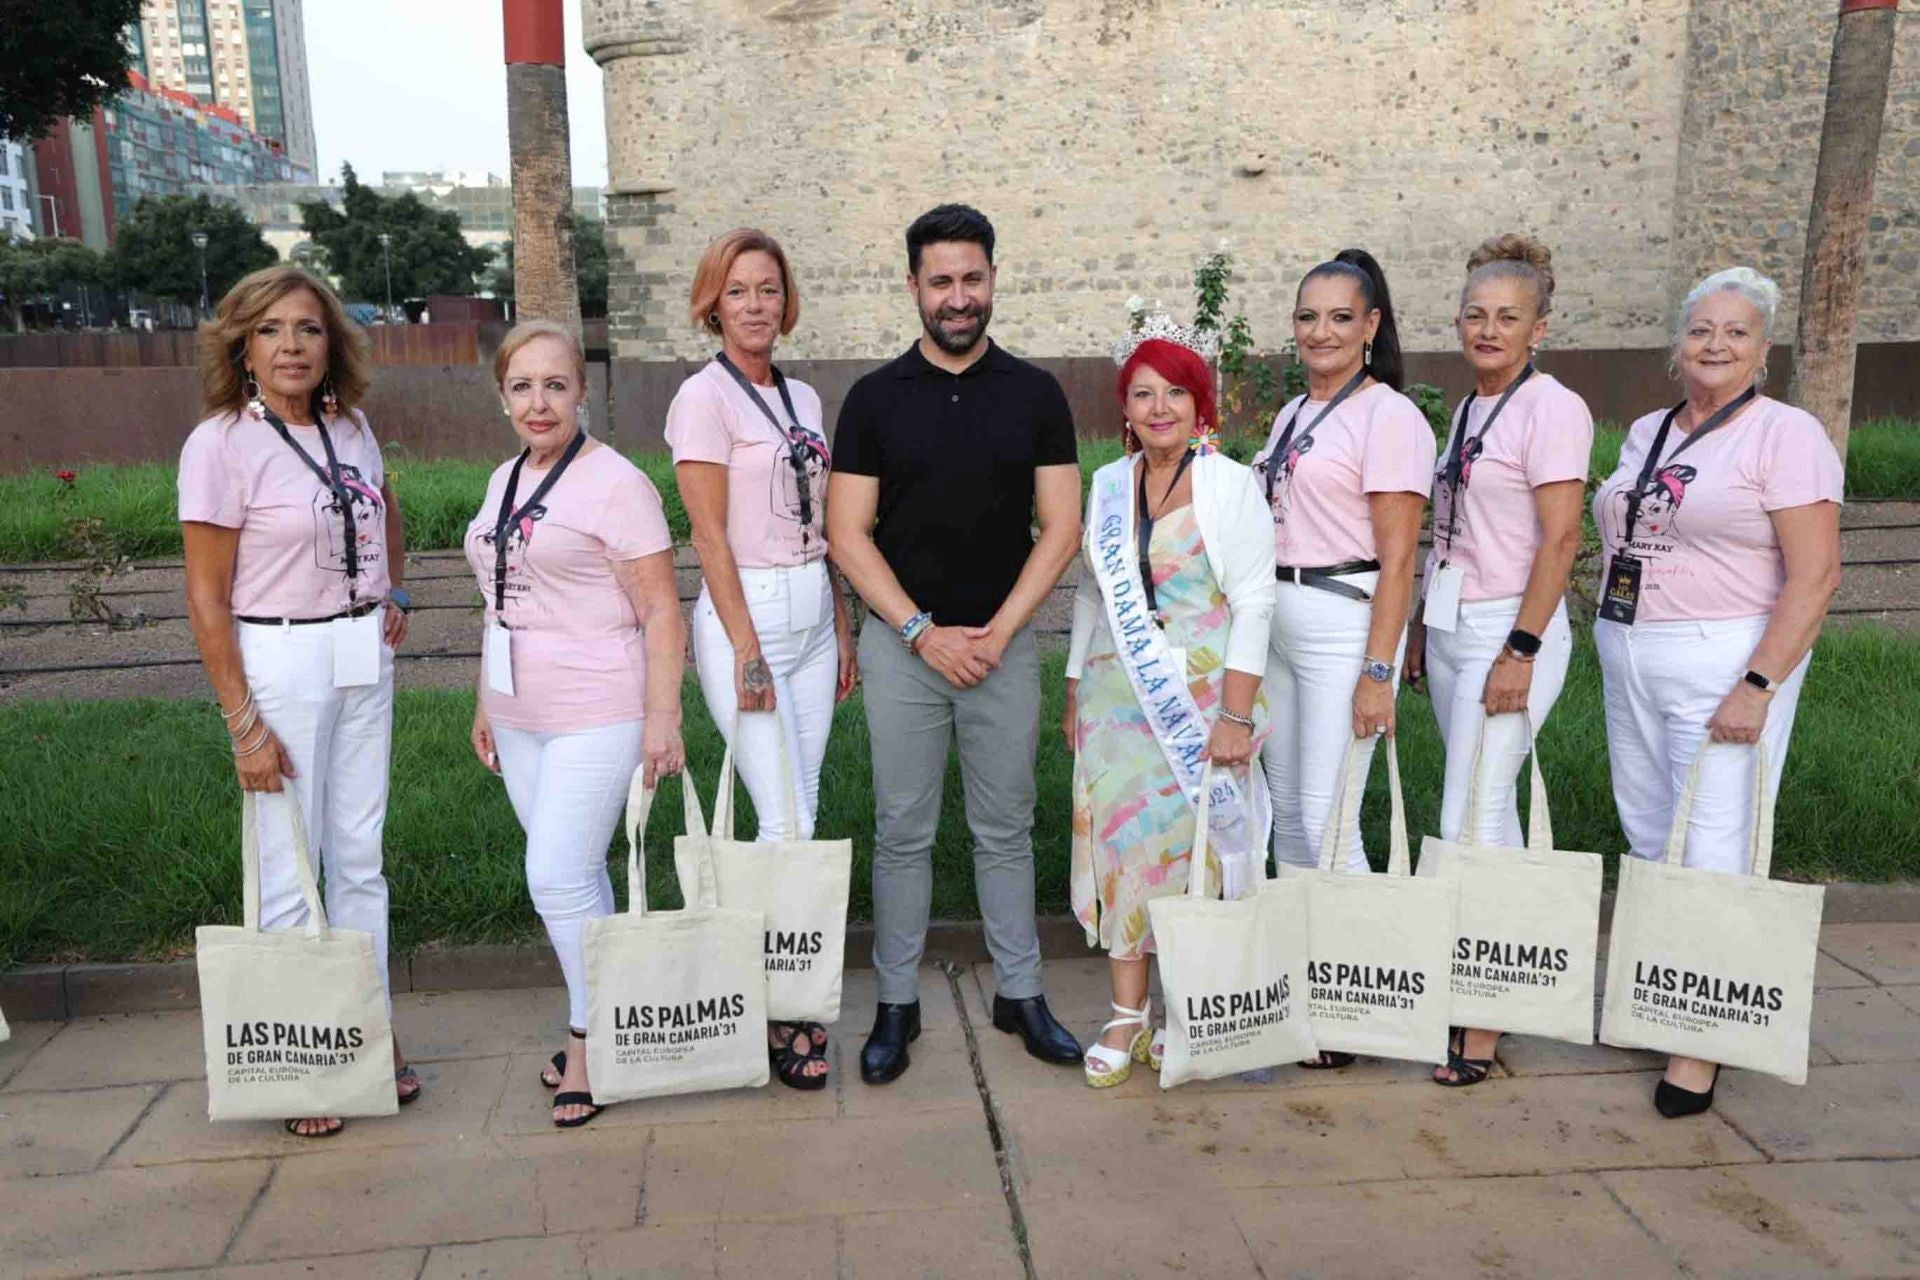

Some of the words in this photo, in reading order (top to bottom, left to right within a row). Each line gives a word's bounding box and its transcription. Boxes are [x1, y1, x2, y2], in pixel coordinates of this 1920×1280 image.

[1654, 543, 1675, 553] KAY
[1099, 514, 1126, 577] GRAN
[1113, 579, 1152, 656] DAMA
[1137, 657, 1169, 694] LA
[1154, 695, 1207, 775] NAVAL
[764, 931, 823, 955] LMAS
[764, 958, 812, 971] ARIA'31
[1476, 939, 1569, 972] PALMAS
[1307, 960, 1332, 984] AS
[1337, 963, 1425, 995] PALMAS
[1485, 967, 1556, 987] CANARIA'31
[1635, 960, 1678, 991] LAS
[1682, 971, 1784, 1011] PALMAS
[1187, 995, 1226, 1021] LAS
[1230, 973, 1290, 1017] PALMAS
[1311, 987, 1342, 1002] GRAN
[1346, 990, 1415, 1011] CANARIA'31
[1634, 987, 1649, 1002] DE
[1652, 992, 1688, 1011] GRAN
[1691, 1001, 1769, 1027] CANARIA'31
[615, 1005, 654, 1029] LAS
[658, 993, 745, 1028] PALMAS
[1632, 1003, 1670, 1019] CAPITAL
[1673, 1013, 1719, 1029] EUROPEA
[226, 1021, 269, 1048] LAS
[273, 1023, 364, 1050] PALMAS
[615, 1033, 631, 1046] DE
[633, 1031, 666, 1045] GRAN
[669, 1022, 736, 1044] CANARIA'31
[1189, 1024, 1203, 1039] DE
[1207, 1020, 1236, 1037] GRAN
[1646, 1015, 1658, 1025] LA
[1660, 1018, 1704, 1033] CULTURA
[227, 1051, 243, 1064] DE
[247, 1050, 282, 1063] GRAN
[285, 1050, 355, 1066] CANARIA'31
[243, 1075, 256, 1083] LA
